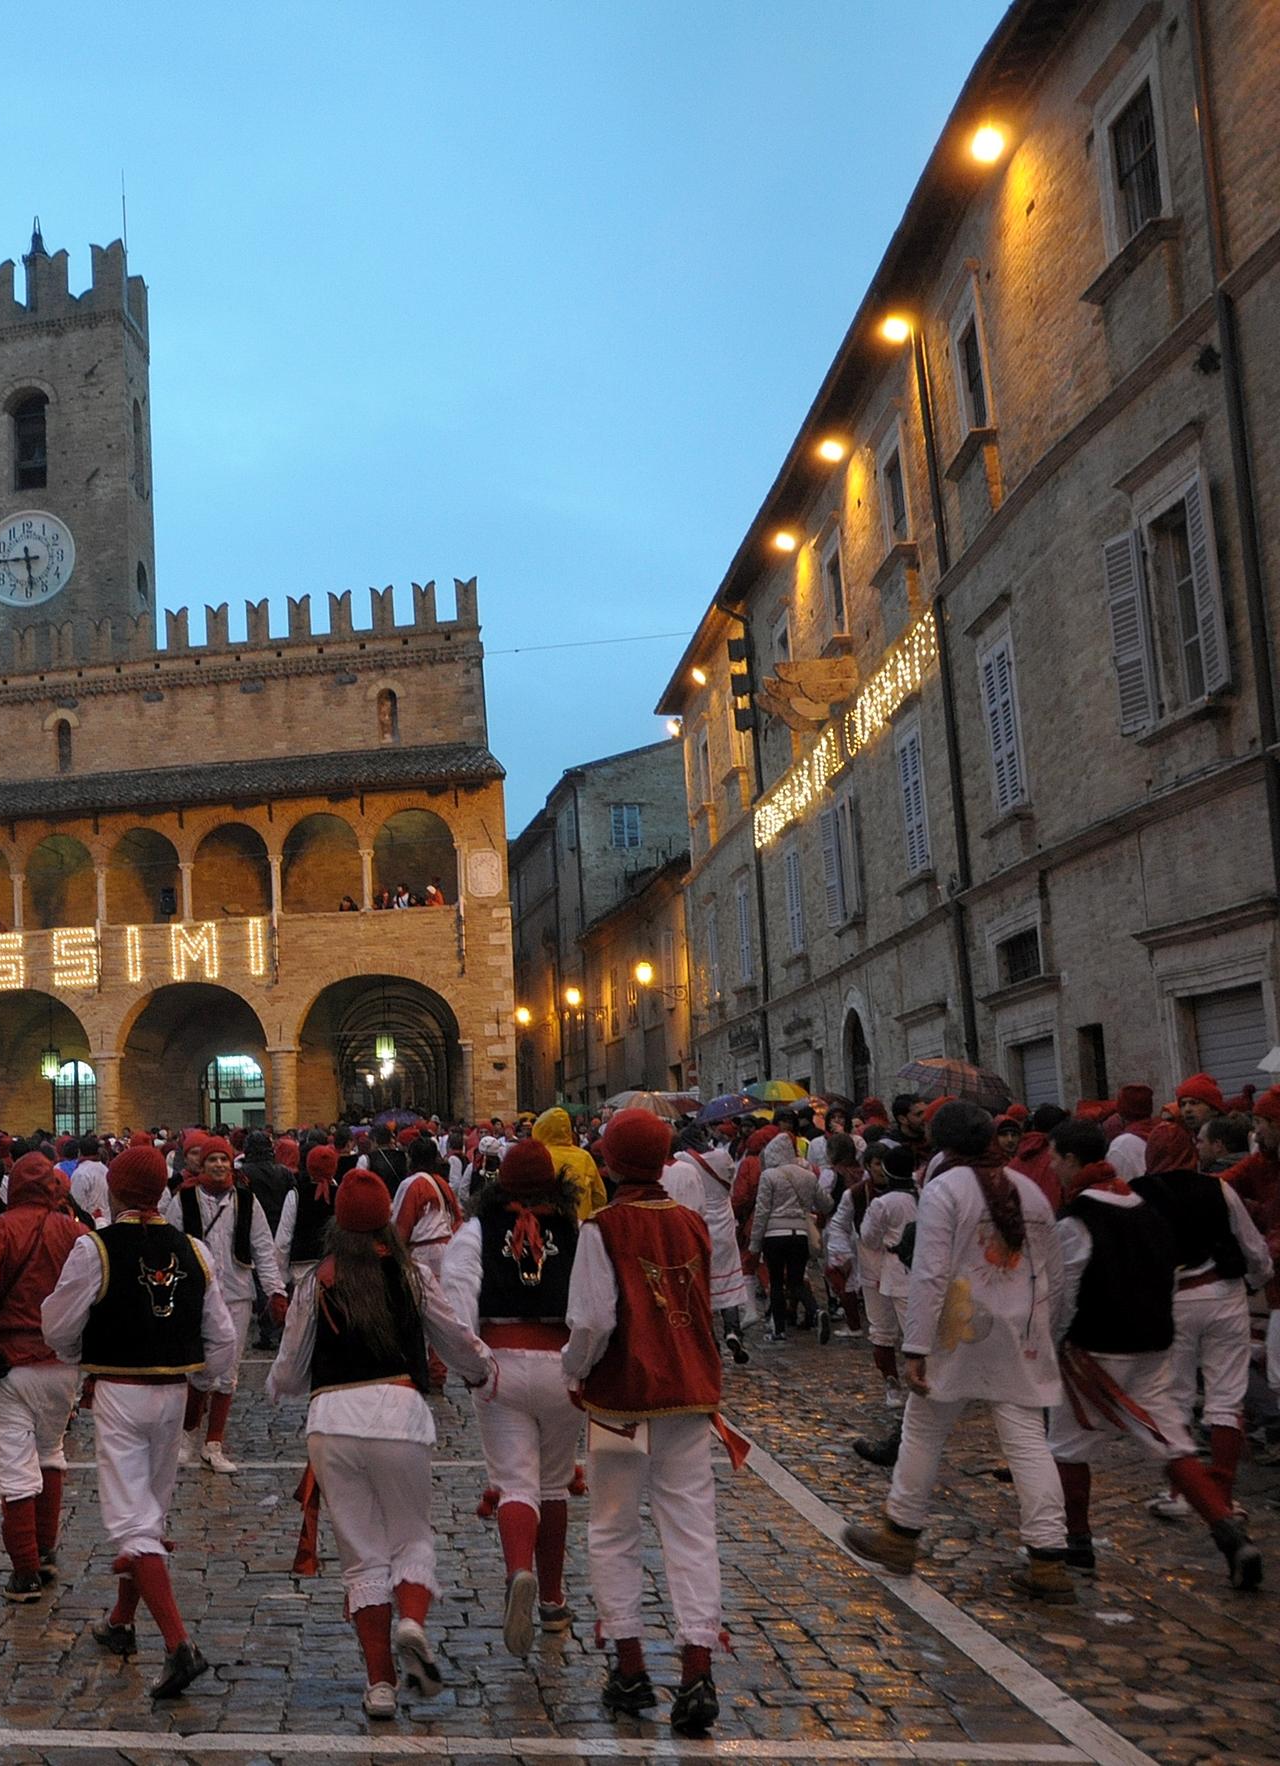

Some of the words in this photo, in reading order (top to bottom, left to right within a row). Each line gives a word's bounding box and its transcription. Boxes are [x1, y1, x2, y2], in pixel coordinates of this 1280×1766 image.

[9, 526, 16, 541] 11
[22, 520, 33, 534] 12
[42, 523, 46, 536] 1
[51, 533, 59, 546] 2
[57, 548, 64, 562] 3
[9, 584, 16, 596] 7
[25, 586, 33, 599] 6
